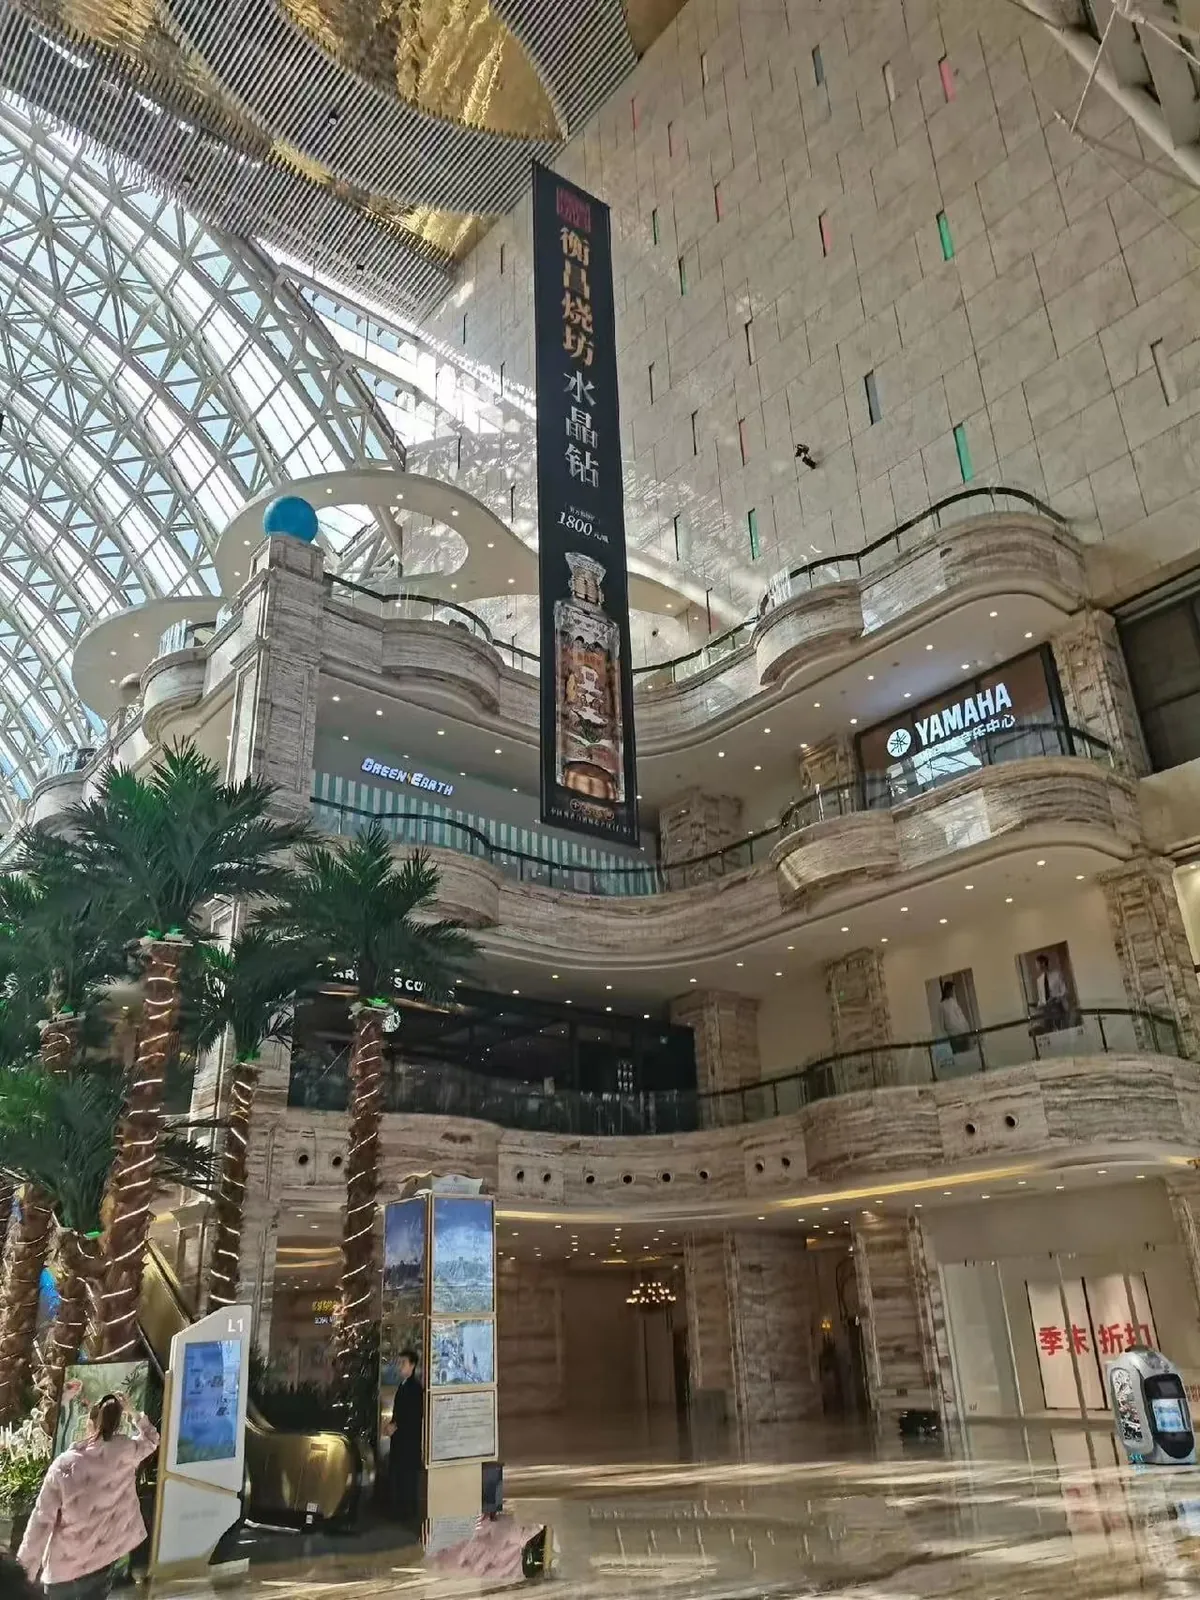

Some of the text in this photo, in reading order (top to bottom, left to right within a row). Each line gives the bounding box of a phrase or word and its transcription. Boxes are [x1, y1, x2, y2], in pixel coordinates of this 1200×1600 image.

[563, 370, 599, 488] 水晶钻
[557, 511, 593, 536] 1800
[915, 682, 1012, 746] YAMAHA
[361, 757, 454, 796] GREEN EARTH
[228, 1318, 244, 1332] L1
